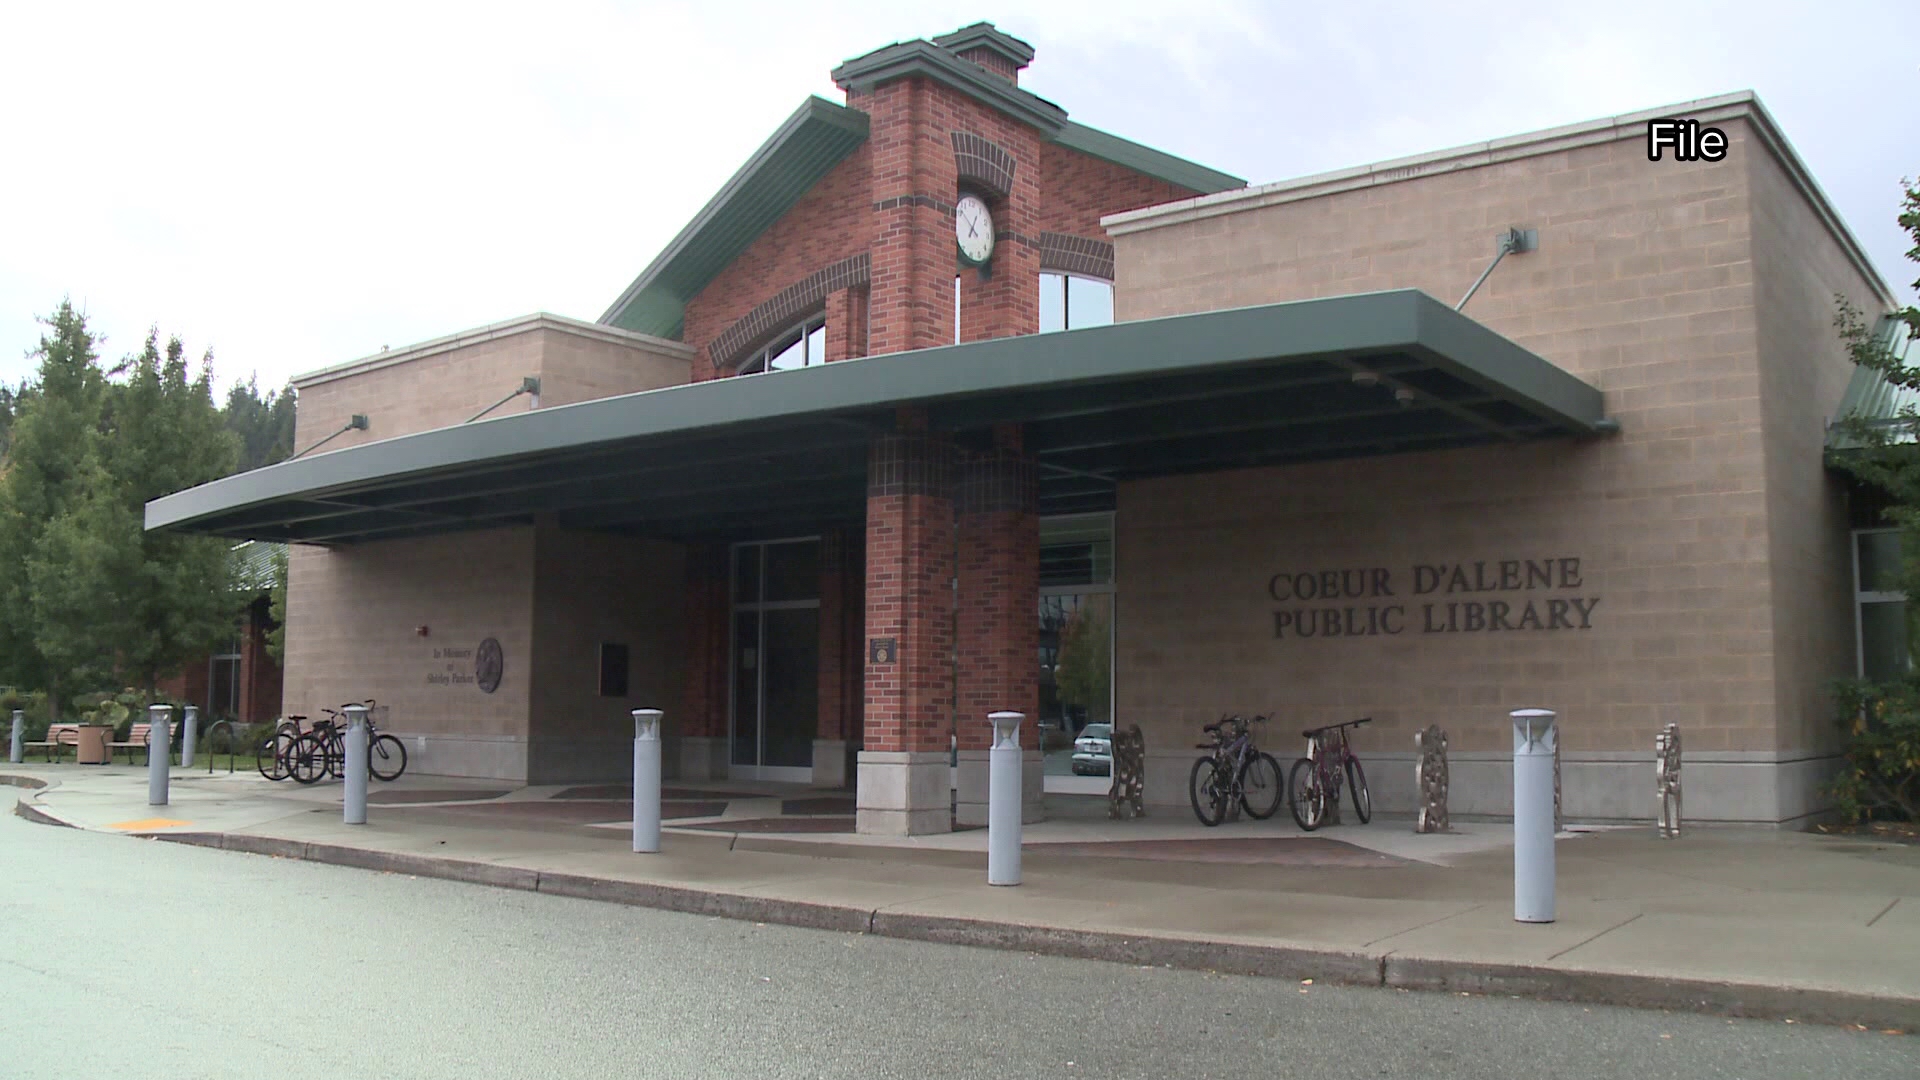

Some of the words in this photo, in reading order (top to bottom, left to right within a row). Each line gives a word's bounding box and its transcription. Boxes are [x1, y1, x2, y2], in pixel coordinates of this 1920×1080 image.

[1268, 568, 1394, 602] COEUR
[1412, 557, 1583, 595] D'ALENE
[1272, 605, 1404, 640] PUBLIC
[1422, 597, 1600, 634] LIBRARY
